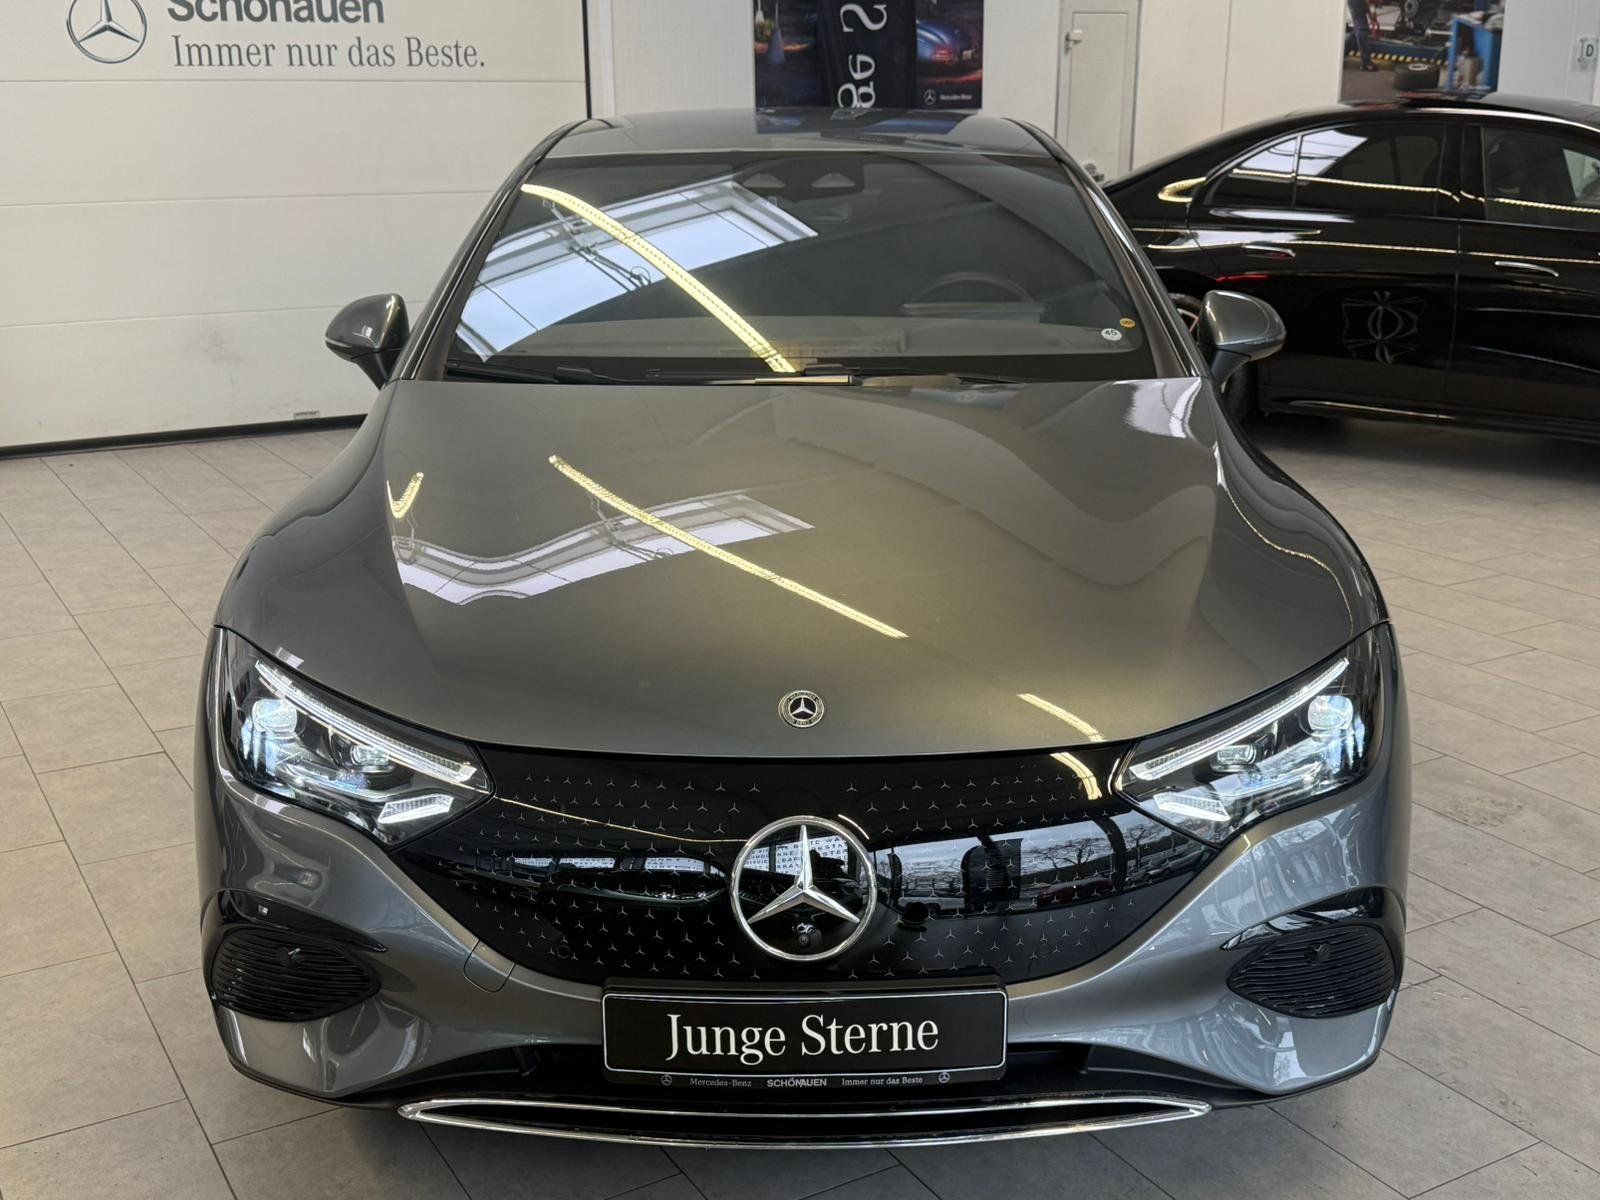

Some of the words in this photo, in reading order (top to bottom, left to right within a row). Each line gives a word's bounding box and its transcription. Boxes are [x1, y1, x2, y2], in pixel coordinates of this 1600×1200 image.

[171, 34, 276, 67] Immer
[285, 41, 338, 67] nur
[347, 36, 396, 67] das
[404, 36, 485, 67] Beste.
[665, 1013, 786, 1066] Junge
[801, 1013, 939, 1056] Sterne
[689, 1077, 752, 1087] Mercedes-Benz
[767, 1077, 827, 1088] SCHÖNAUEN
[841, 1078, 869, 1086] Immer
[870, 1078, 885, 1086] nur
[886, 1077, 900, 1085] das
[902, 1076, 923, 1084] Beste
